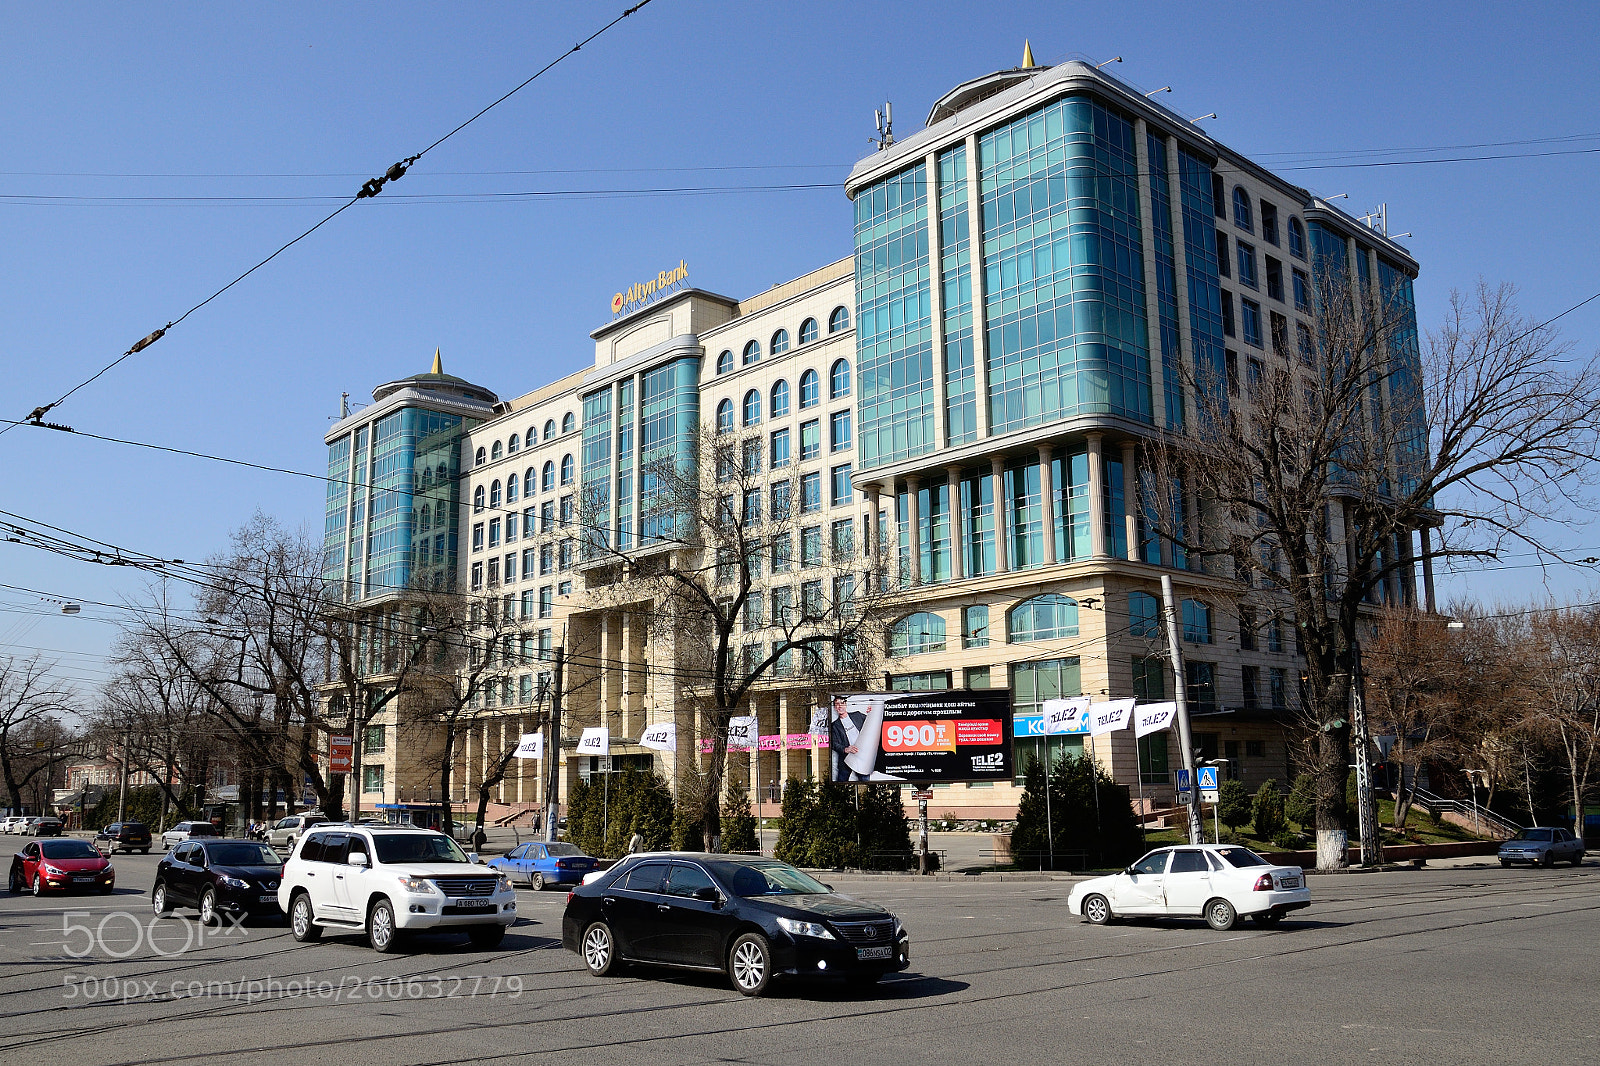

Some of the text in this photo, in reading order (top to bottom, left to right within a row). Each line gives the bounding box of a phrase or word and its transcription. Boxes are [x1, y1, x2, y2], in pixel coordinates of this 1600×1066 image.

[625, 259, 689, 305] Altyn Bank
[1051, 706, 1077, 723] TELE2
[1097, 709, 1123, 726] TELE2
[1142, 711, 1168, 727] TELE2
[887, 725, 936, 747] 990
[971, 752, 1004, 766] TELE2
